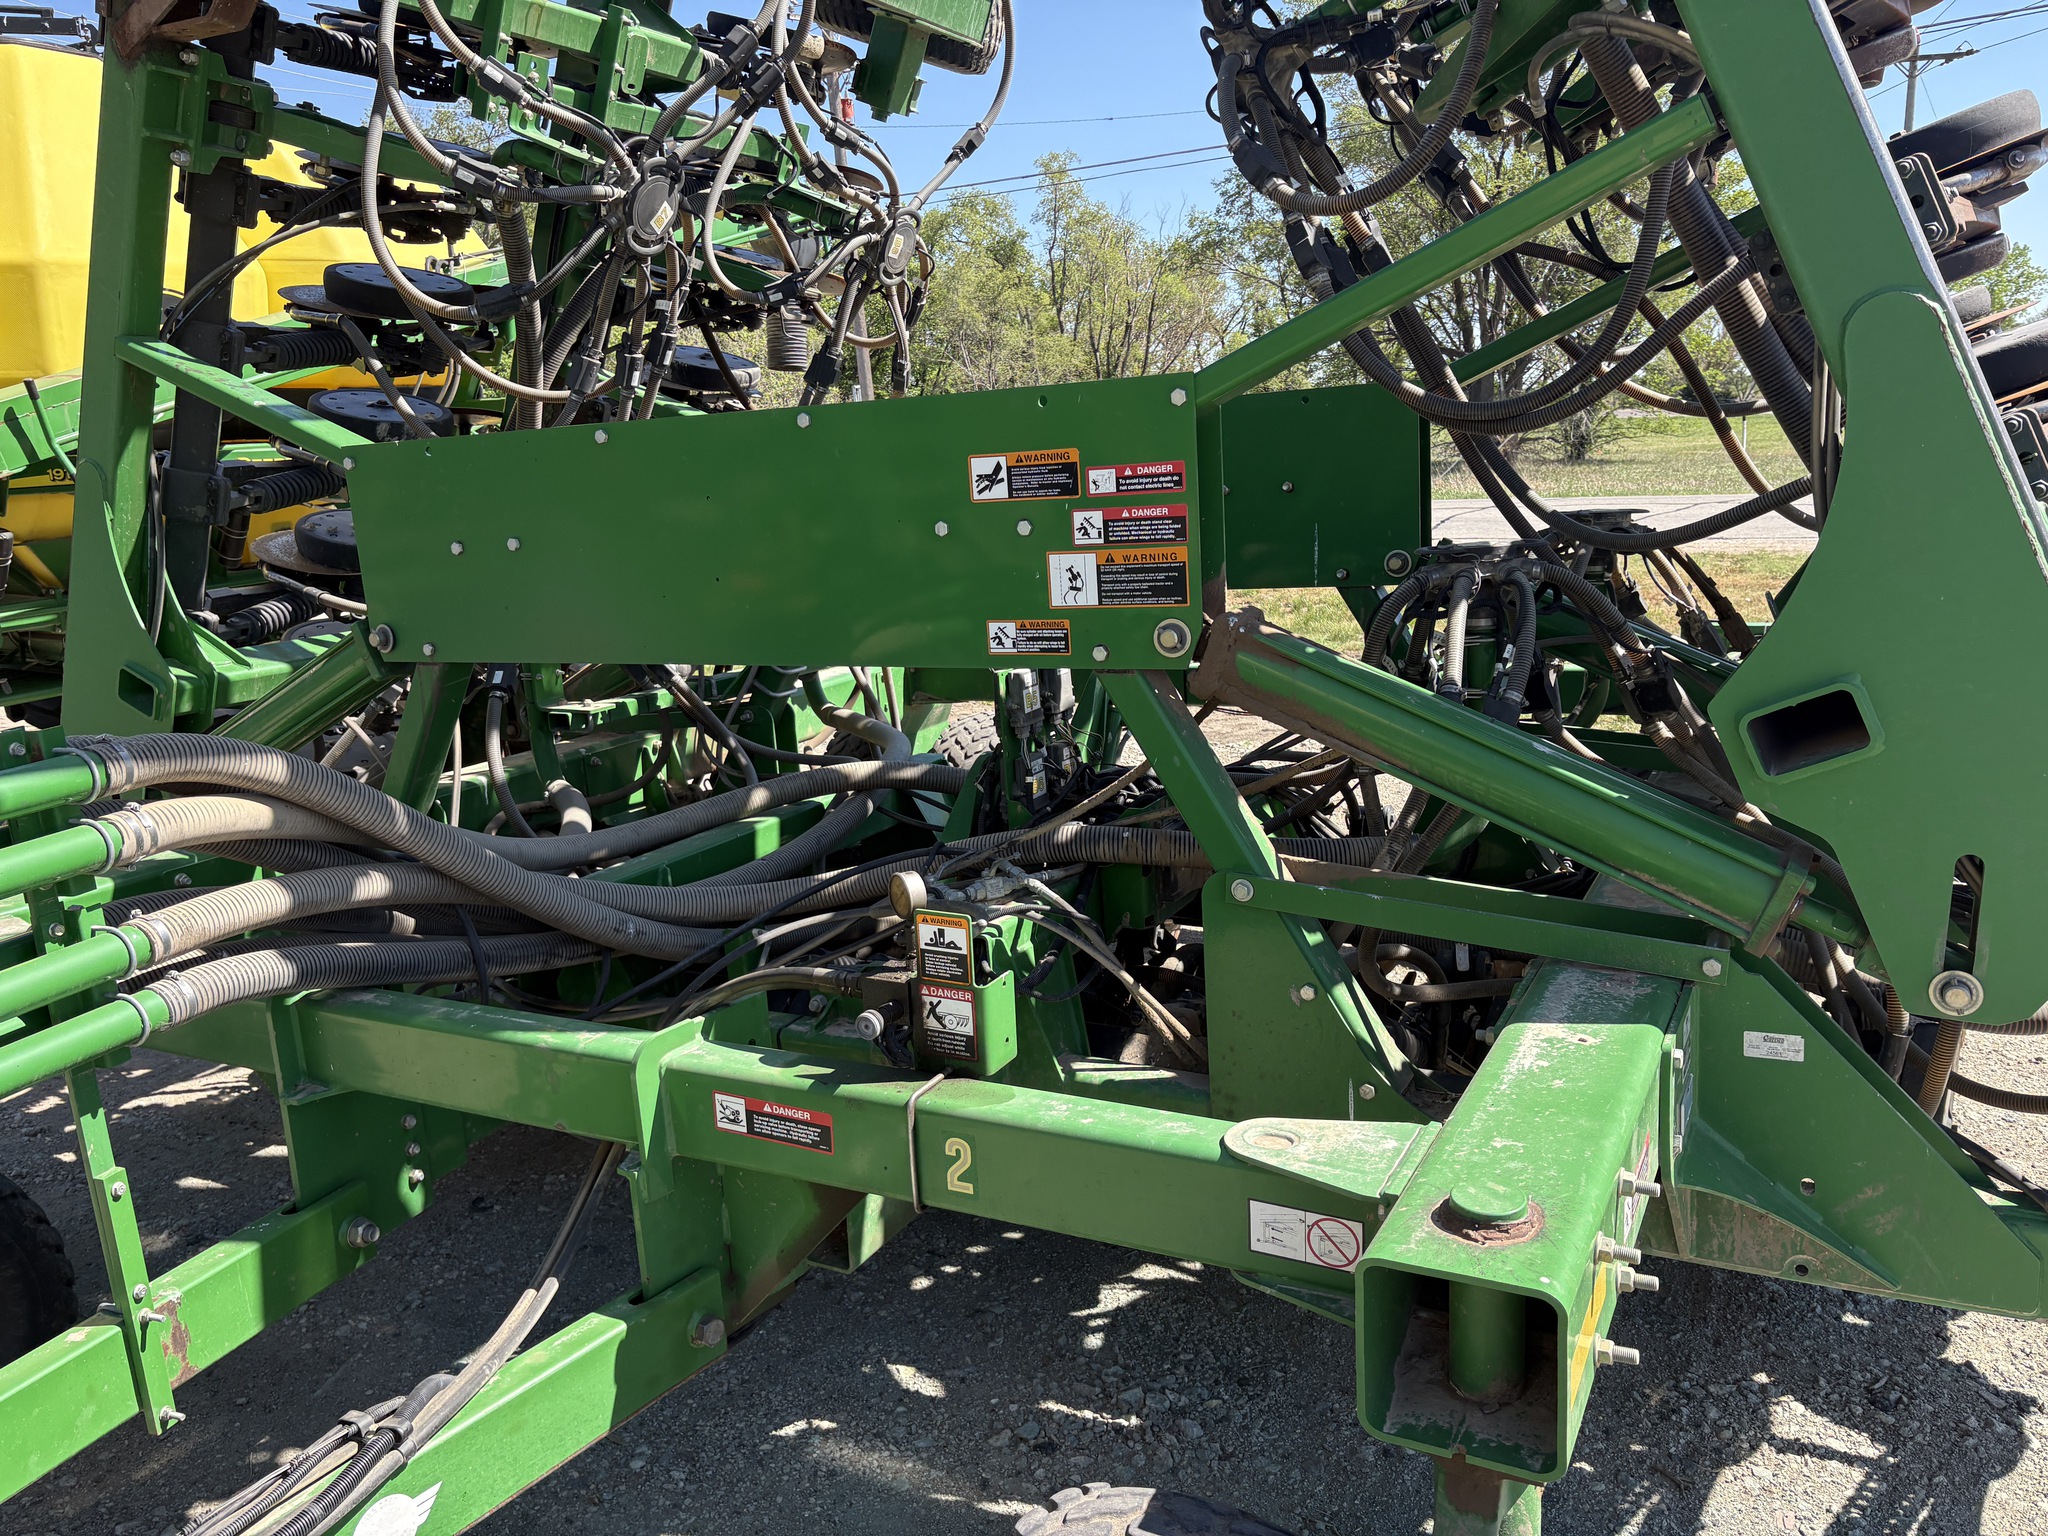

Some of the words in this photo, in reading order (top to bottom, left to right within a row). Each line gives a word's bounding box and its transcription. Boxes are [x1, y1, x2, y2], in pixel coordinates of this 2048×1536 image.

[1024, 452, 1070, 462] WARNING
[1137, 465, 1173, 474] DANGER
[1132, 508, 1168, 516] DANGER
[1122, 552, 1178, 562] WARNING
[930, 917, 962, 926] WARNING
[931, 987, 971, 1001] DANGER
[773, 1106, 810, 1120] DANGER
[945, 1137, 974, 1194] 2
